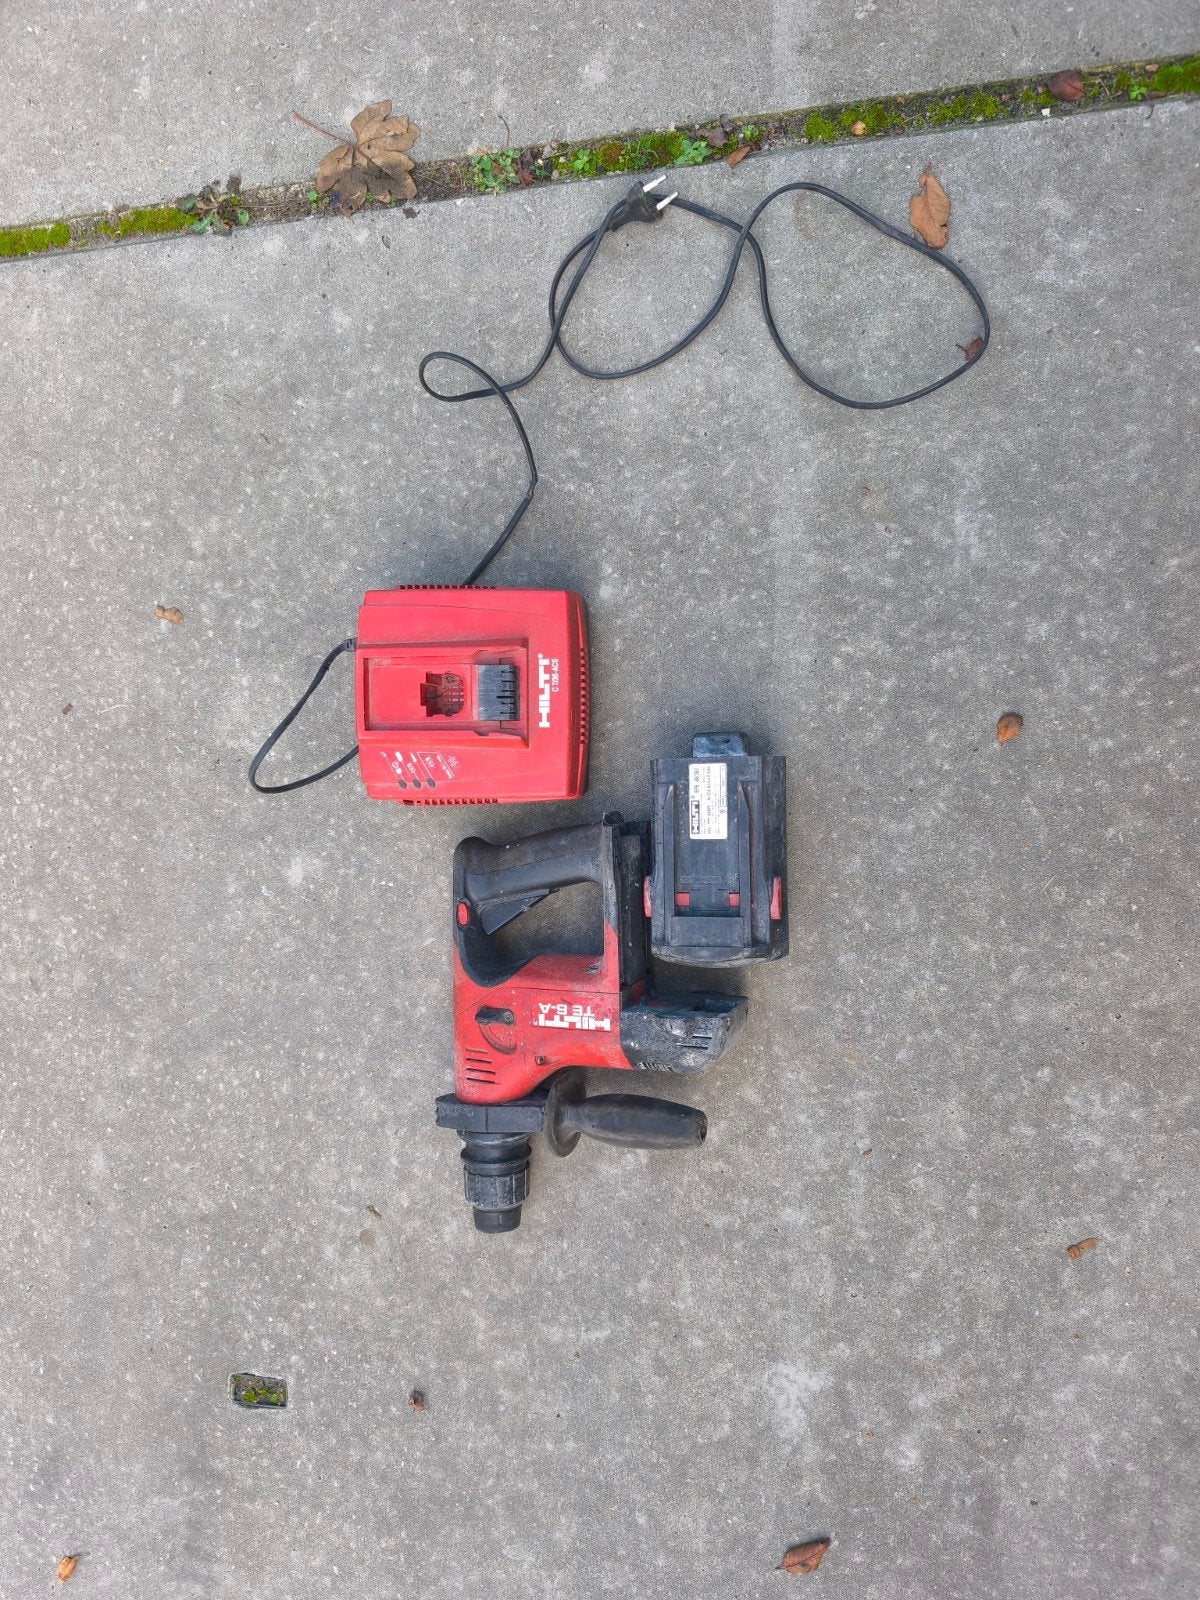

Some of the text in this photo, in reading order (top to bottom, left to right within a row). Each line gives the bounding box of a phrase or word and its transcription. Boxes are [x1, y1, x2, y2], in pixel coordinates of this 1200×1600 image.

[538, 658, 550, 728] HILTI
[691, 801, 700, 834] HILTI
[538, 1002, 595, 1016] TE 6-A
[538, 1013, 611, 1031] HILTI
